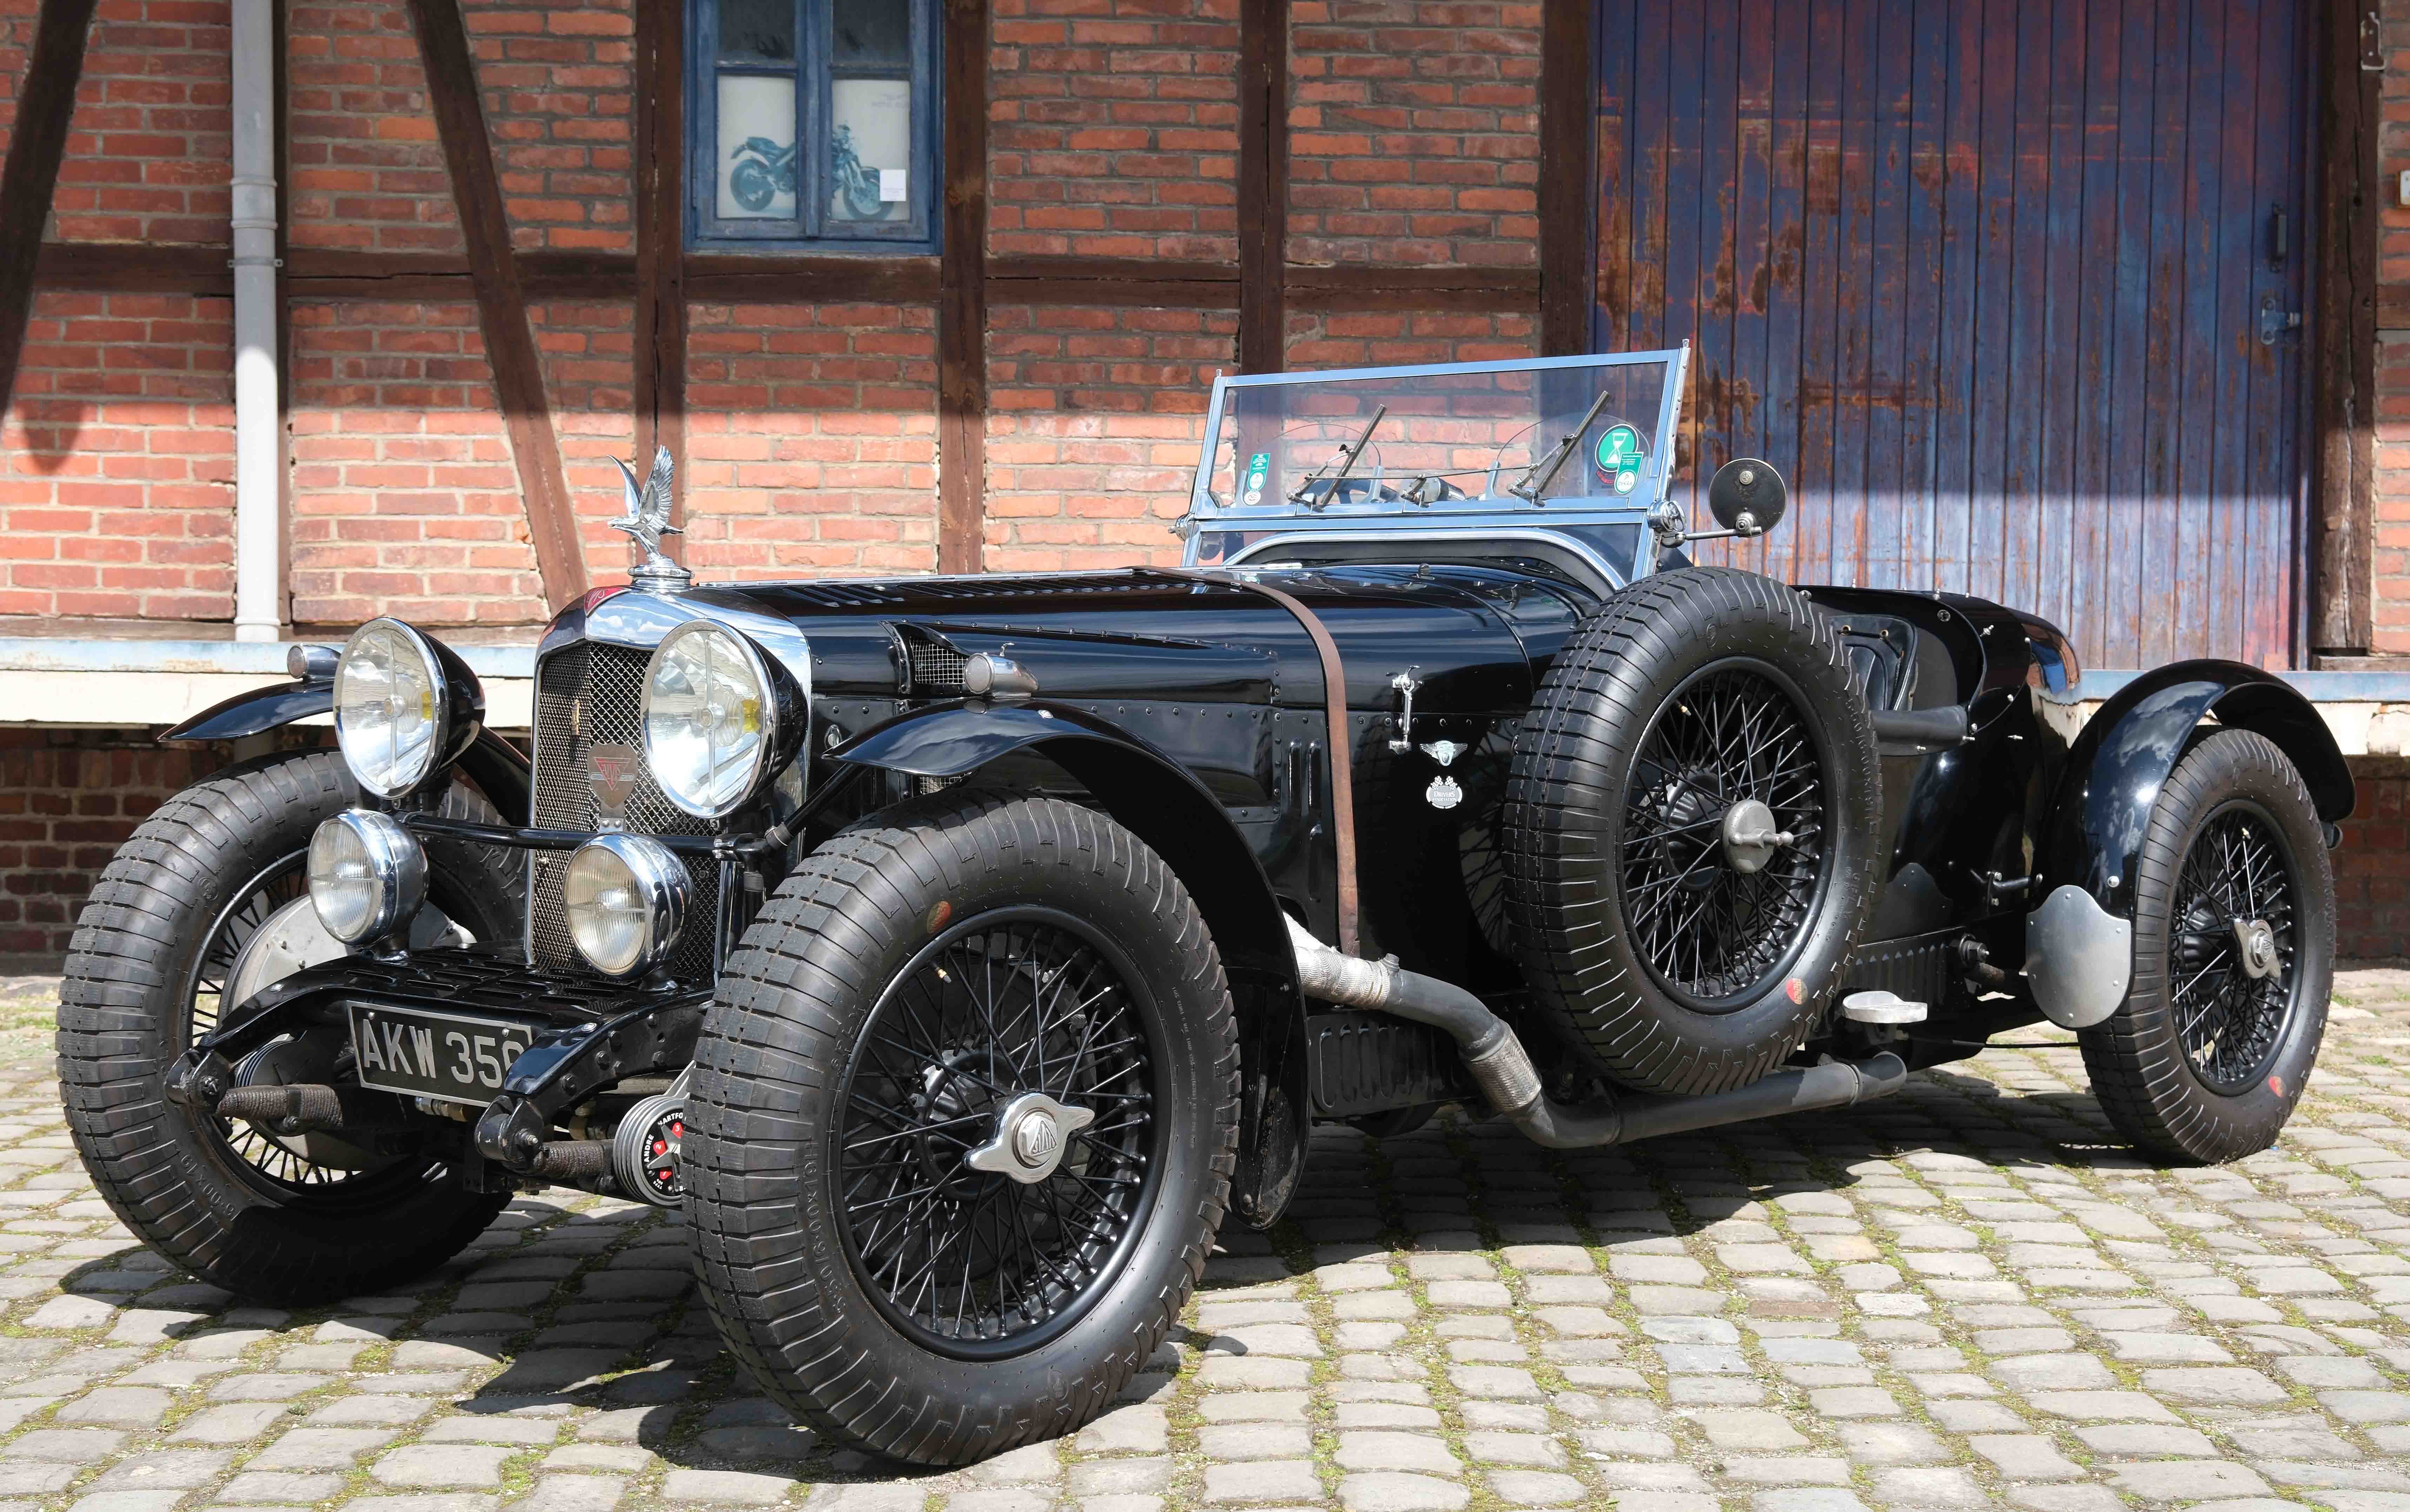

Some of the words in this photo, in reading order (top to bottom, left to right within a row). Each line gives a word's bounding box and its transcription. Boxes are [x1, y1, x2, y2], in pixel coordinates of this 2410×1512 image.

[603, 764, 621, 785] ALVIS
[363, 1019, 436, 1078] AKW
[644, 1134, 654, 1163] ANDRE
